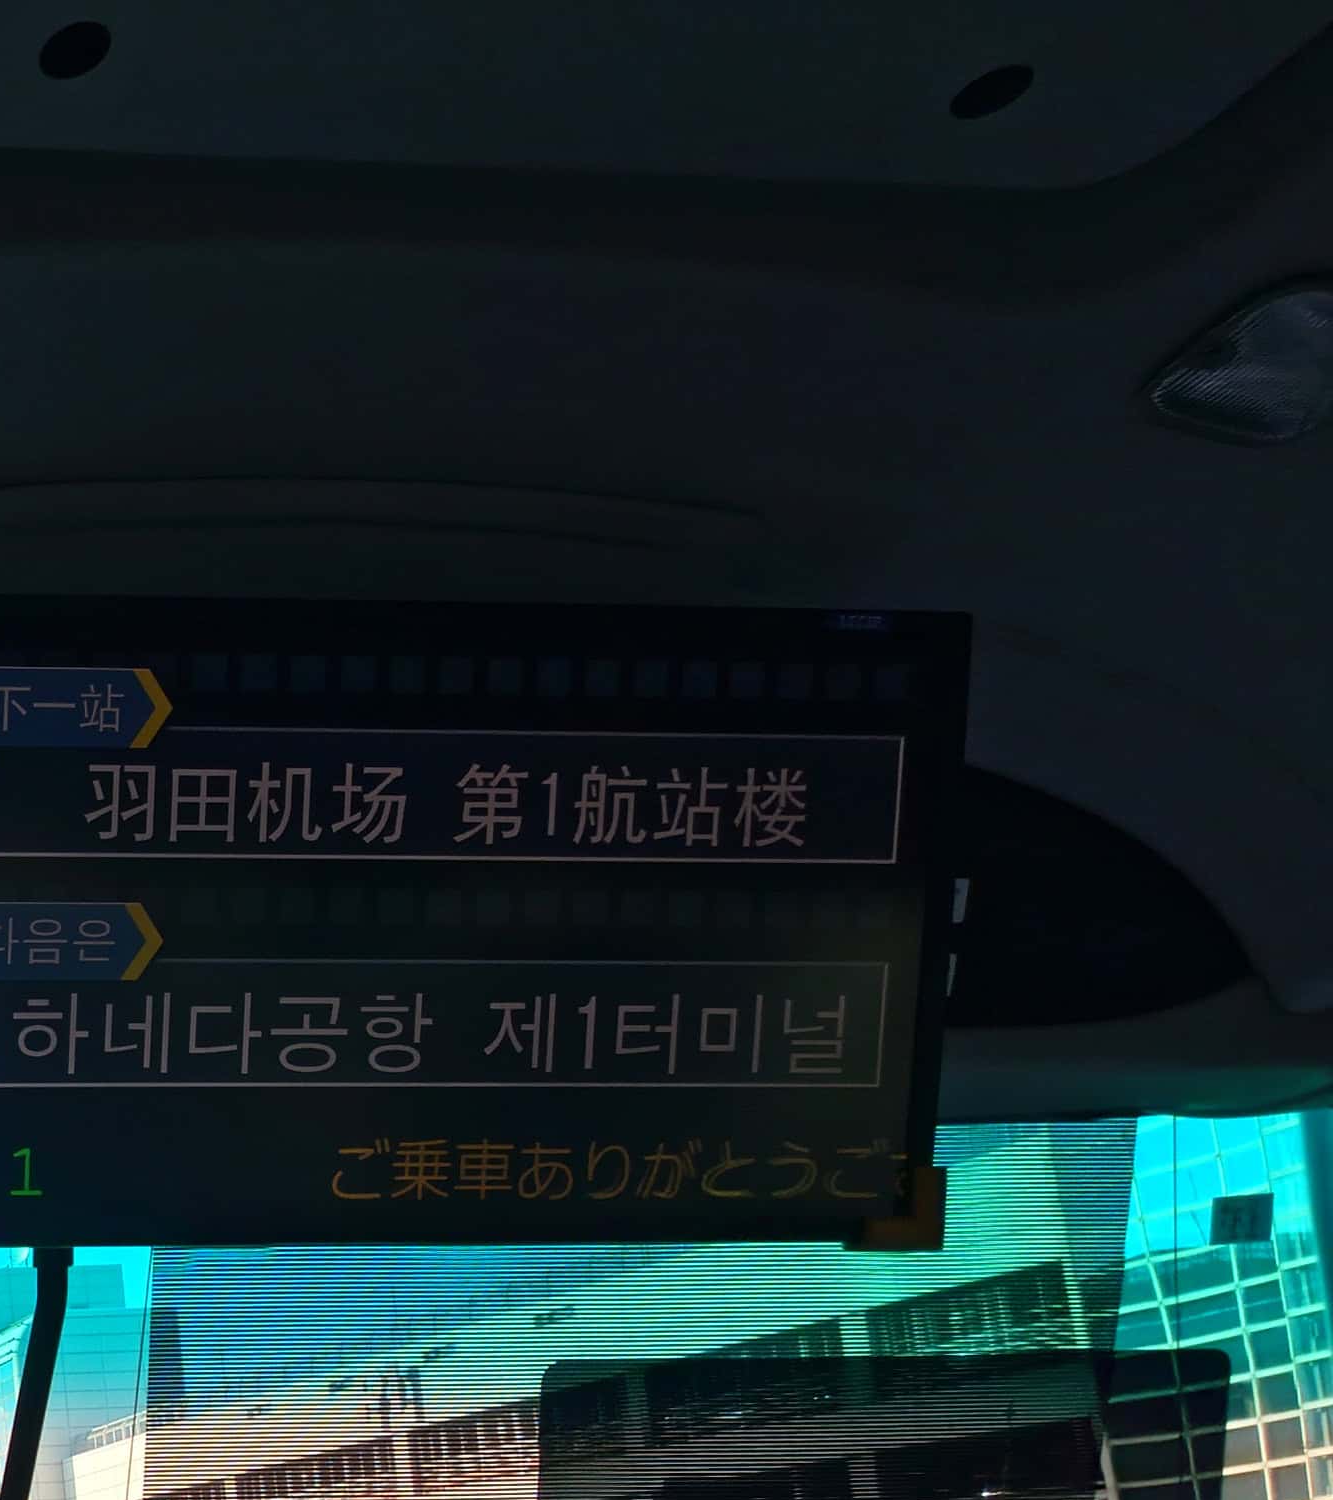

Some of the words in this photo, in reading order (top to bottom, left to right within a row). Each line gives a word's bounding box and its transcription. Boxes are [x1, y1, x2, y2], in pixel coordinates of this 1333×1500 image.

[83, 761, 408, 845] 羽田机场
[454, 763, 809, 848] 第1航站楼
[11, 990, 434, 1076] 하네다공항
[482, 993, 850, 1077] 제1터미널
[10, 1147, 43, 1197] 1
[330, 1136, 909, 1200] ご乗車ありがとうご
